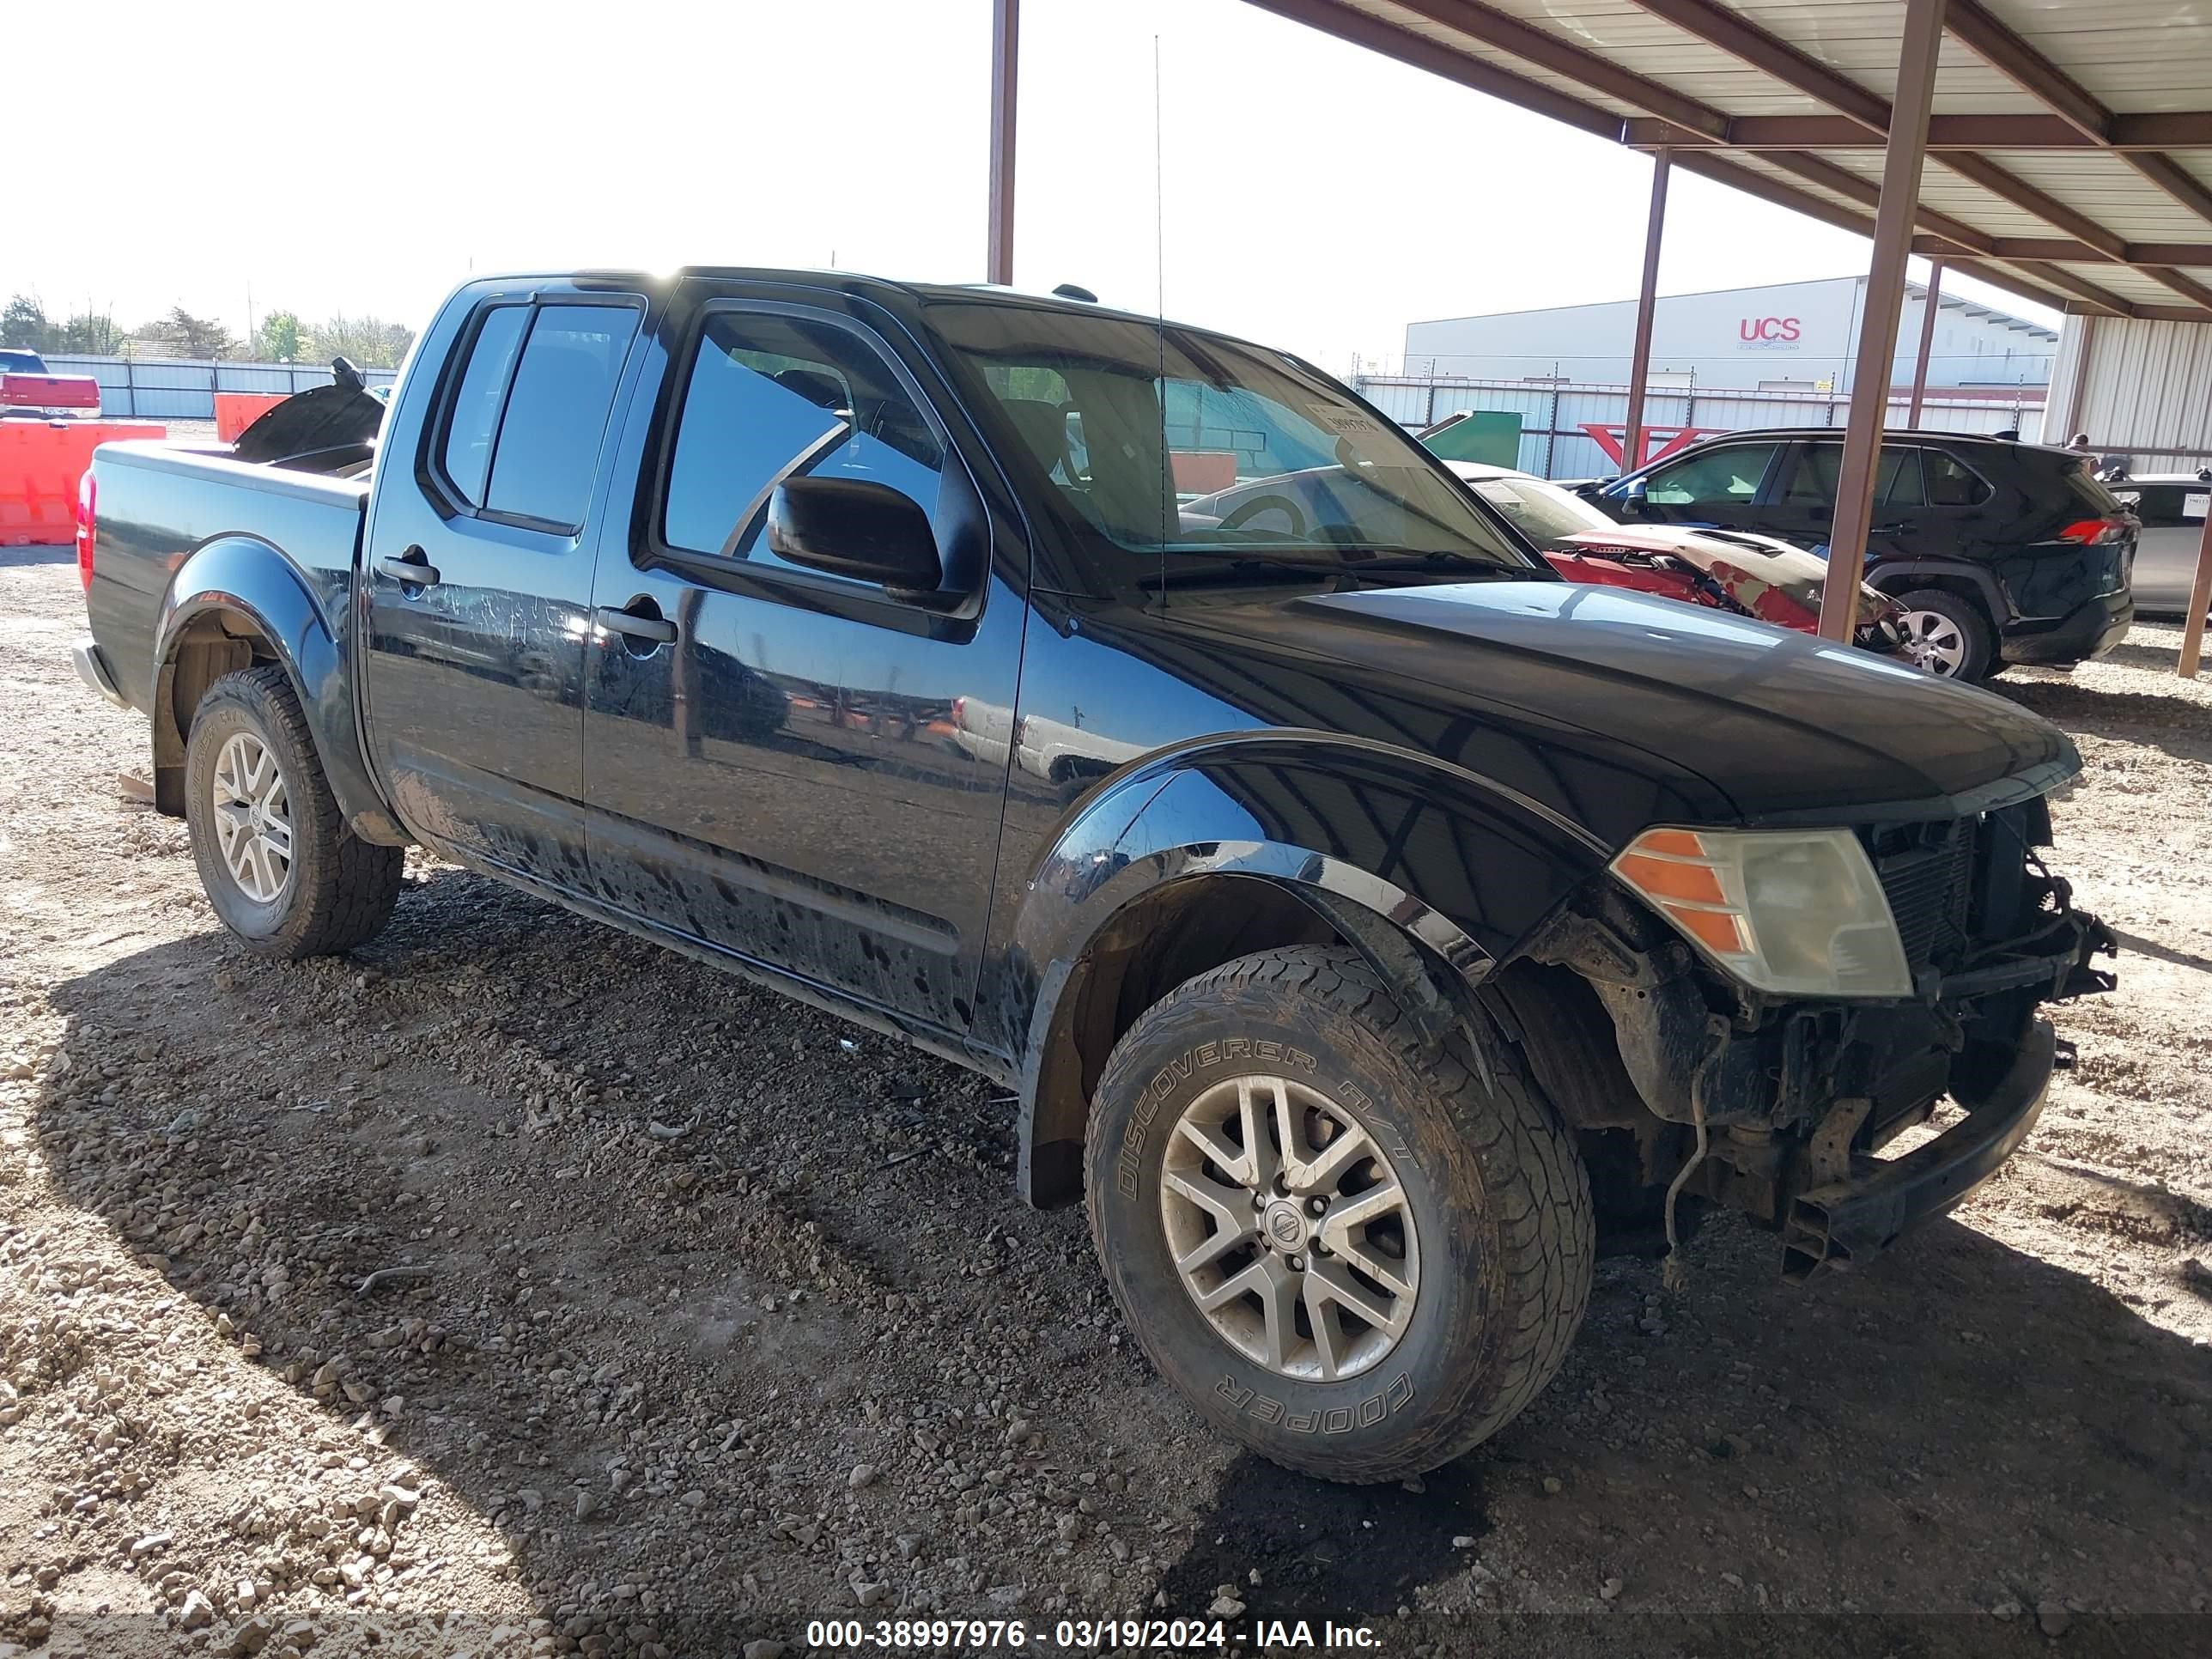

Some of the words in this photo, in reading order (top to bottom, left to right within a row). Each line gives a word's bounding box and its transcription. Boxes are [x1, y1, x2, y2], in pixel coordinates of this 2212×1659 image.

[1740, 317, 1801, 341] UCS
[1118, 1037, 1320, 1202] DISCOVERER
[1337, 1080, 1423, 1170] A/T
[1214, 1370, 1415, 1435] COOPER
